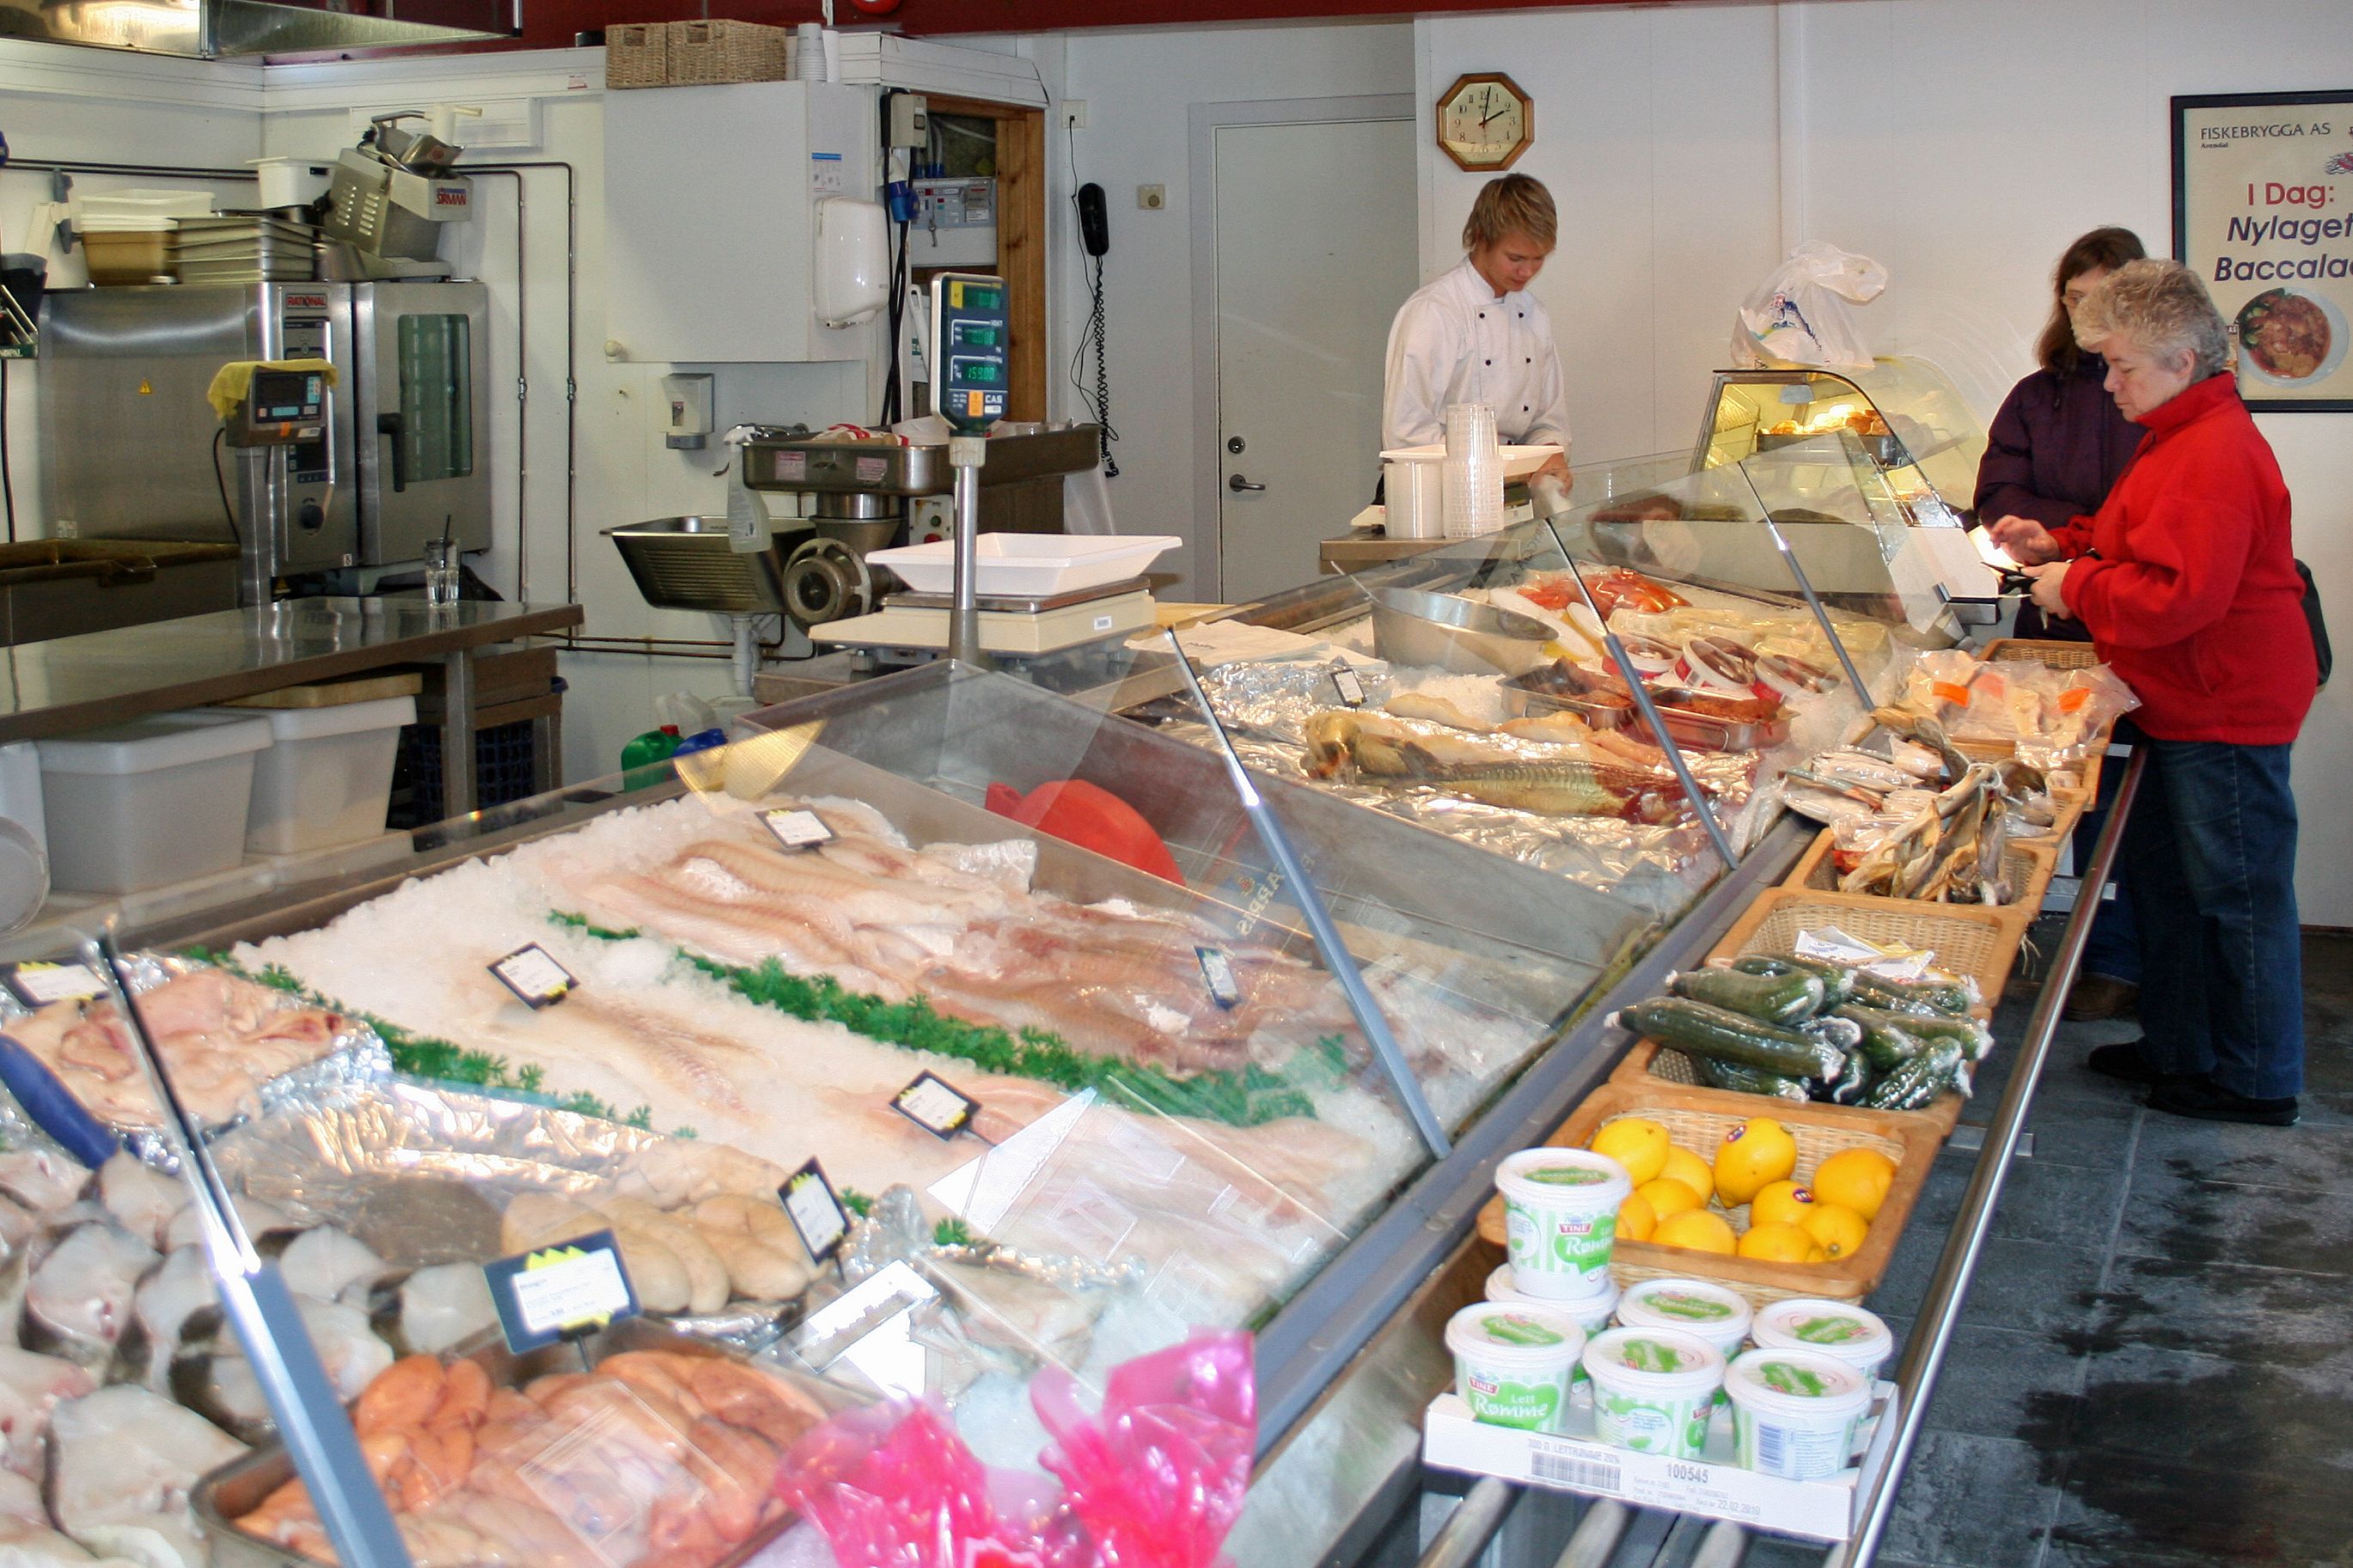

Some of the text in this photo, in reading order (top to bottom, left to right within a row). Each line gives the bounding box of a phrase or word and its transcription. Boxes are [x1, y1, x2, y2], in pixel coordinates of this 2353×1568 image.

[2200, 122, 2332, 140] FISKEBRYGGA AS
[2247, 182, 2335, 210] I Dag:
[2214, 253, 2353, 282] Baccala
[1666, 1462, 1709, 1484] 100545
